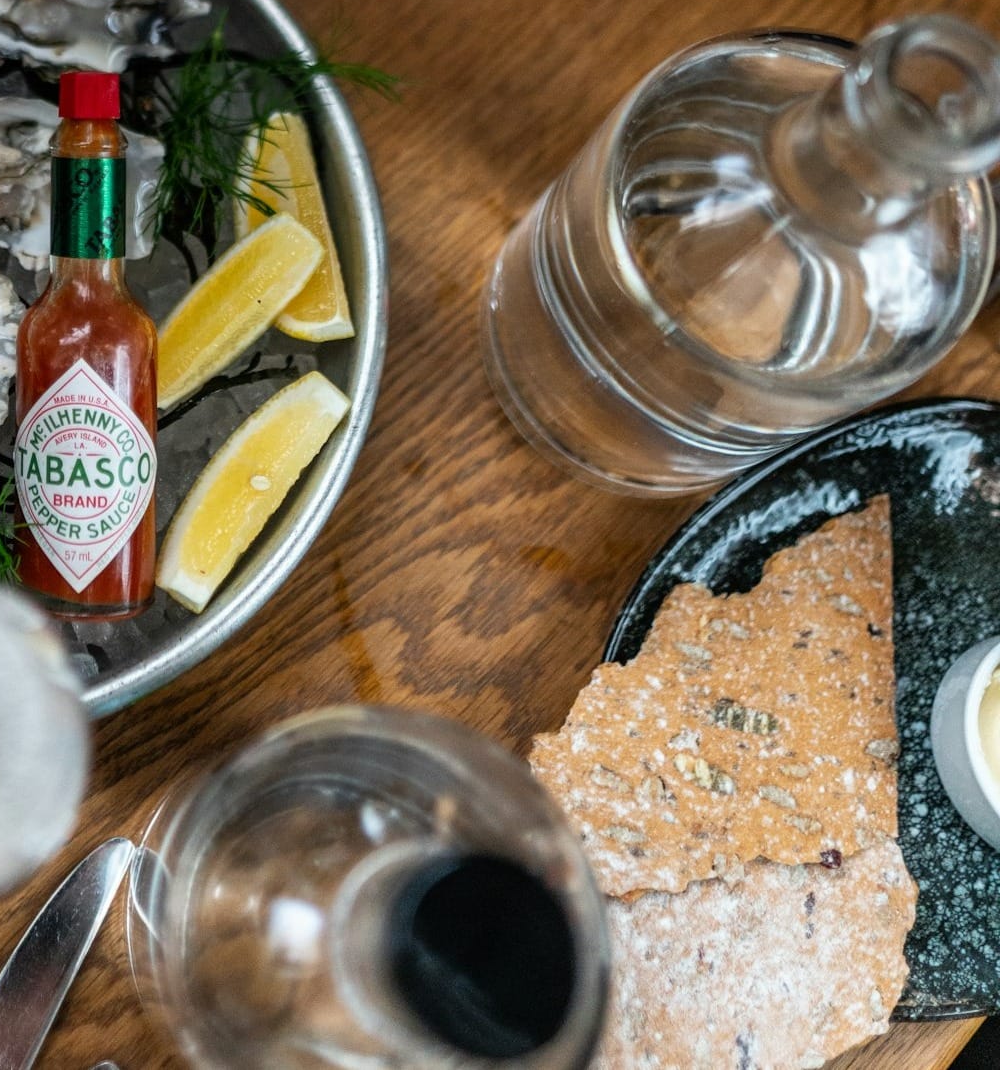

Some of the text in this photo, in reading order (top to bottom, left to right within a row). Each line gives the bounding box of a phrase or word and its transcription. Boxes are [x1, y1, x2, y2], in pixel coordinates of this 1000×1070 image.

[53, 395, 75, 404] MADE
[55, 432, 107, 449] AVERY ISLAND
[18, 446, 151, 489] TABASCO
[53, 494, 108, 509] BRAND
[28, 484, 81, 540] PEPPER
[87, 490, 136, 539] SAUCE
[64, 550, 77, 561] 57
